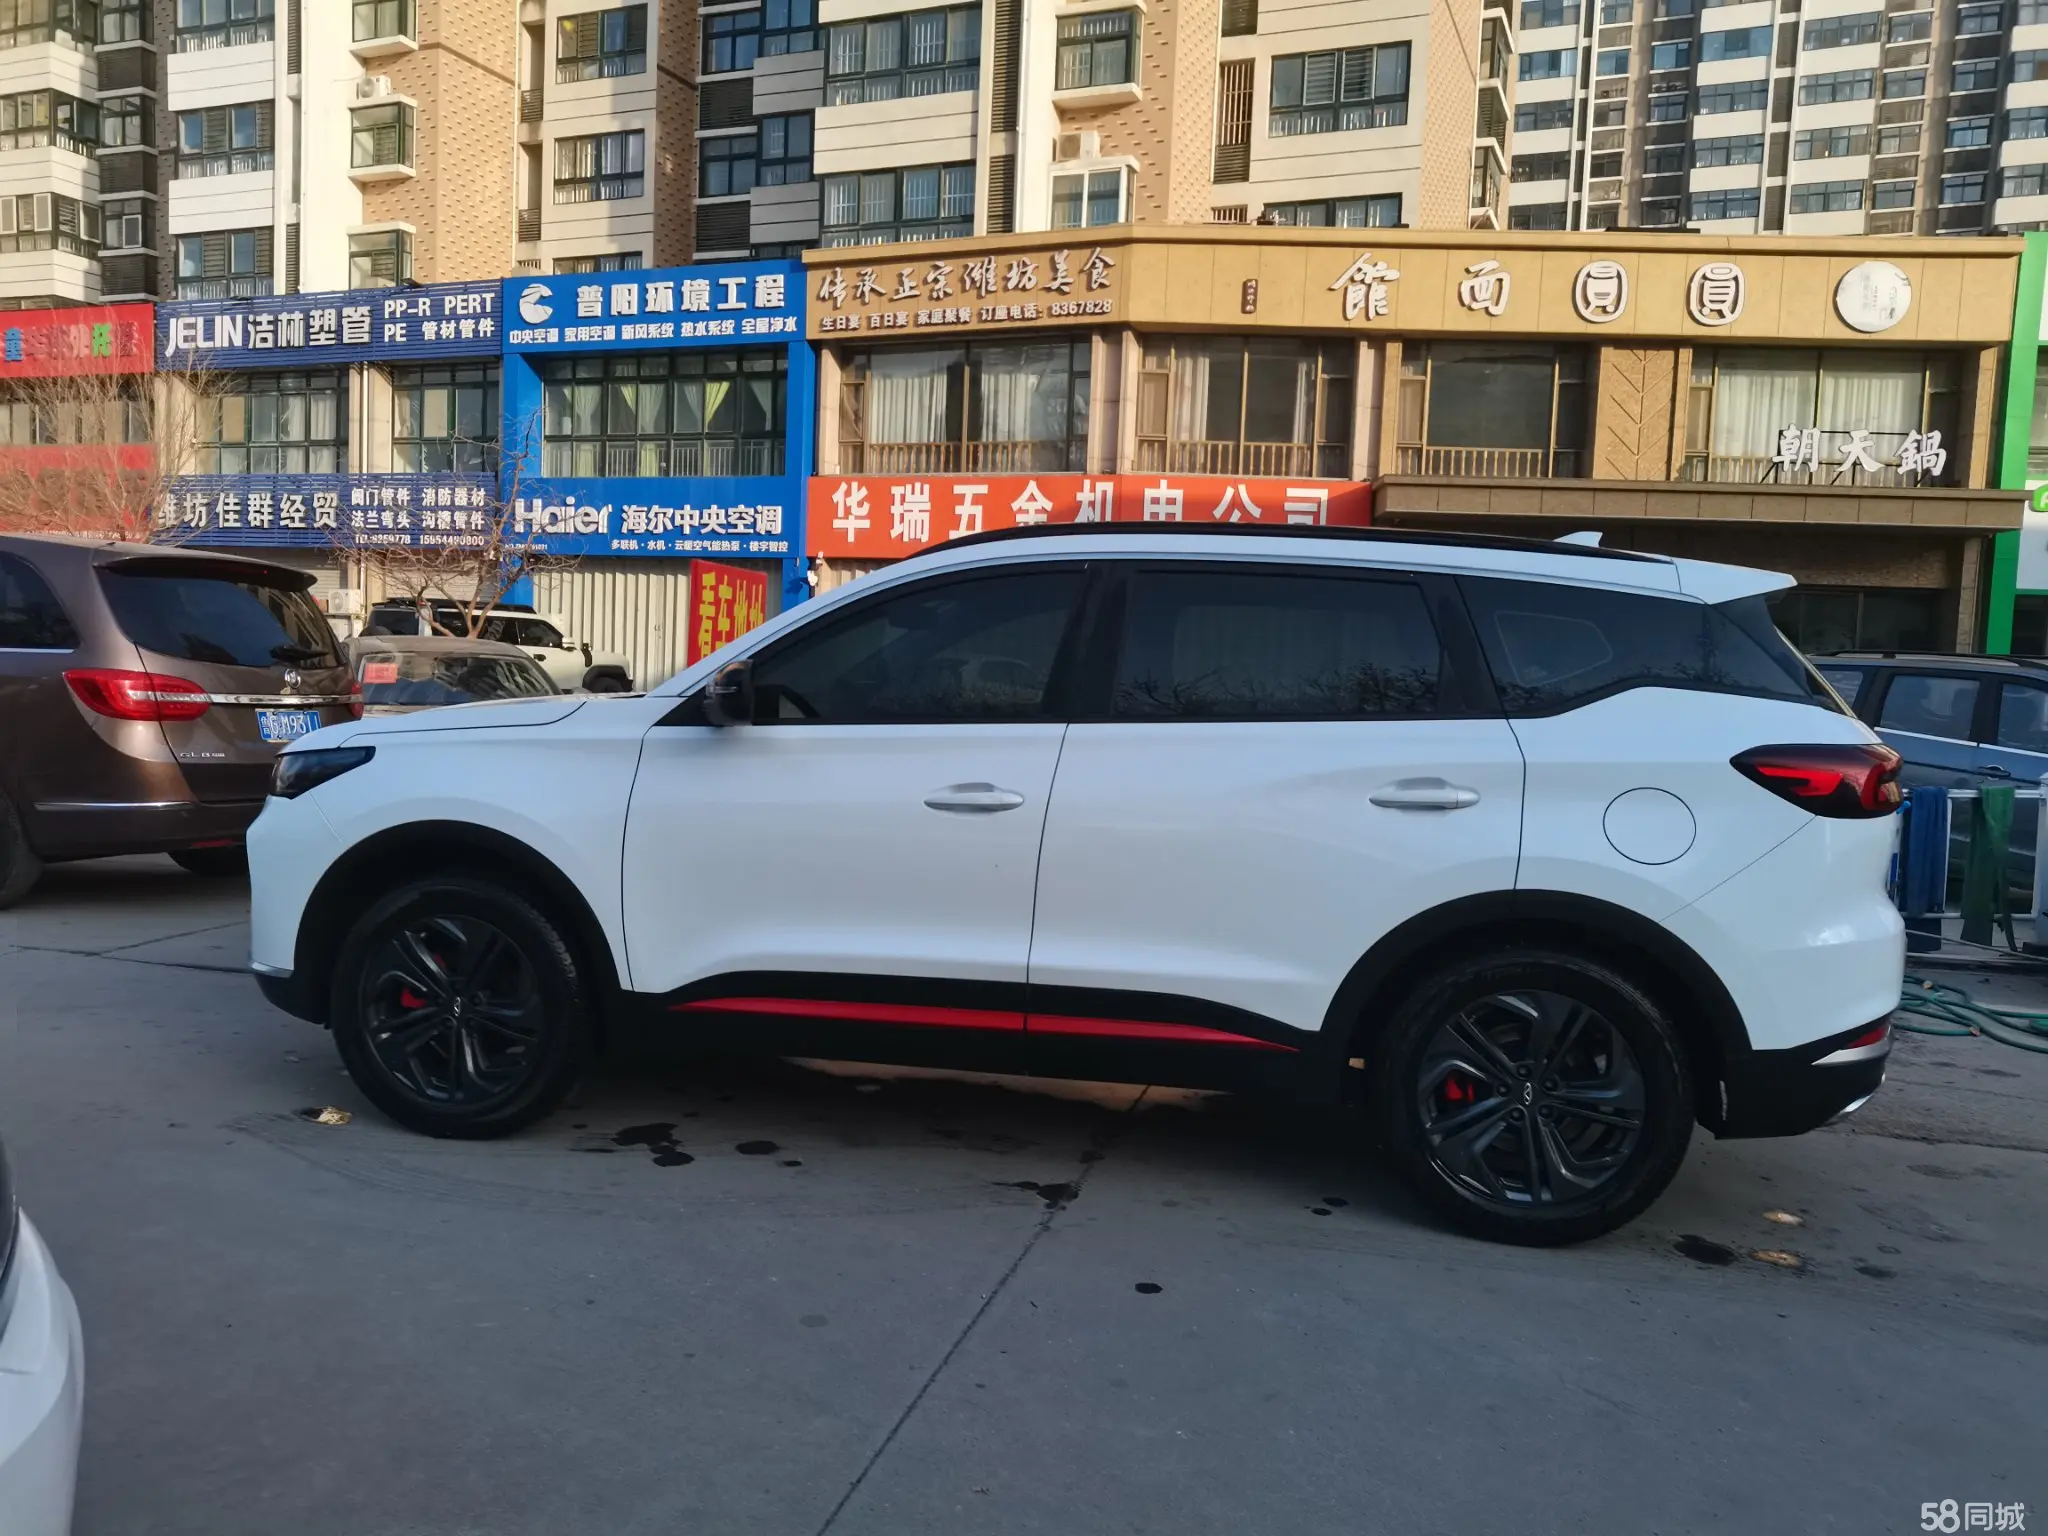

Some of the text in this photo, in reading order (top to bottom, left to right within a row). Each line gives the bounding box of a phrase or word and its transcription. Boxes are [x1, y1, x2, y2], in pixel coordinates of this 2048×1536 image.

[384, 293, 495, 319] PP-R PERT
[577, 274, 785, 318] 普阳环境工程
[384, 317, 495, 342] PE 管材管件
[509, 316, 798, 344] 中央空调 家用空调 新风系统 热水系统 全屋净水
[822, 314, 861, 332] 生日宴
[869, 311, 908, 329] 百日宴
[917, 307, 972, 325] 家庭聚餐
[1051, 299, 1113, 316] 8367828
[165, 315, 243, 357] JELIN
[248, 306, 371, 349] 洁林塑管
[351, 487, 486, 506] 阀门管件 消防器材
[831, 479, 1328, 543] 华瑞五金机电公司
[351, 510, 411, 529] 法兰弯头
[514, 496, 783, 535] Haier 海尔中央空调
